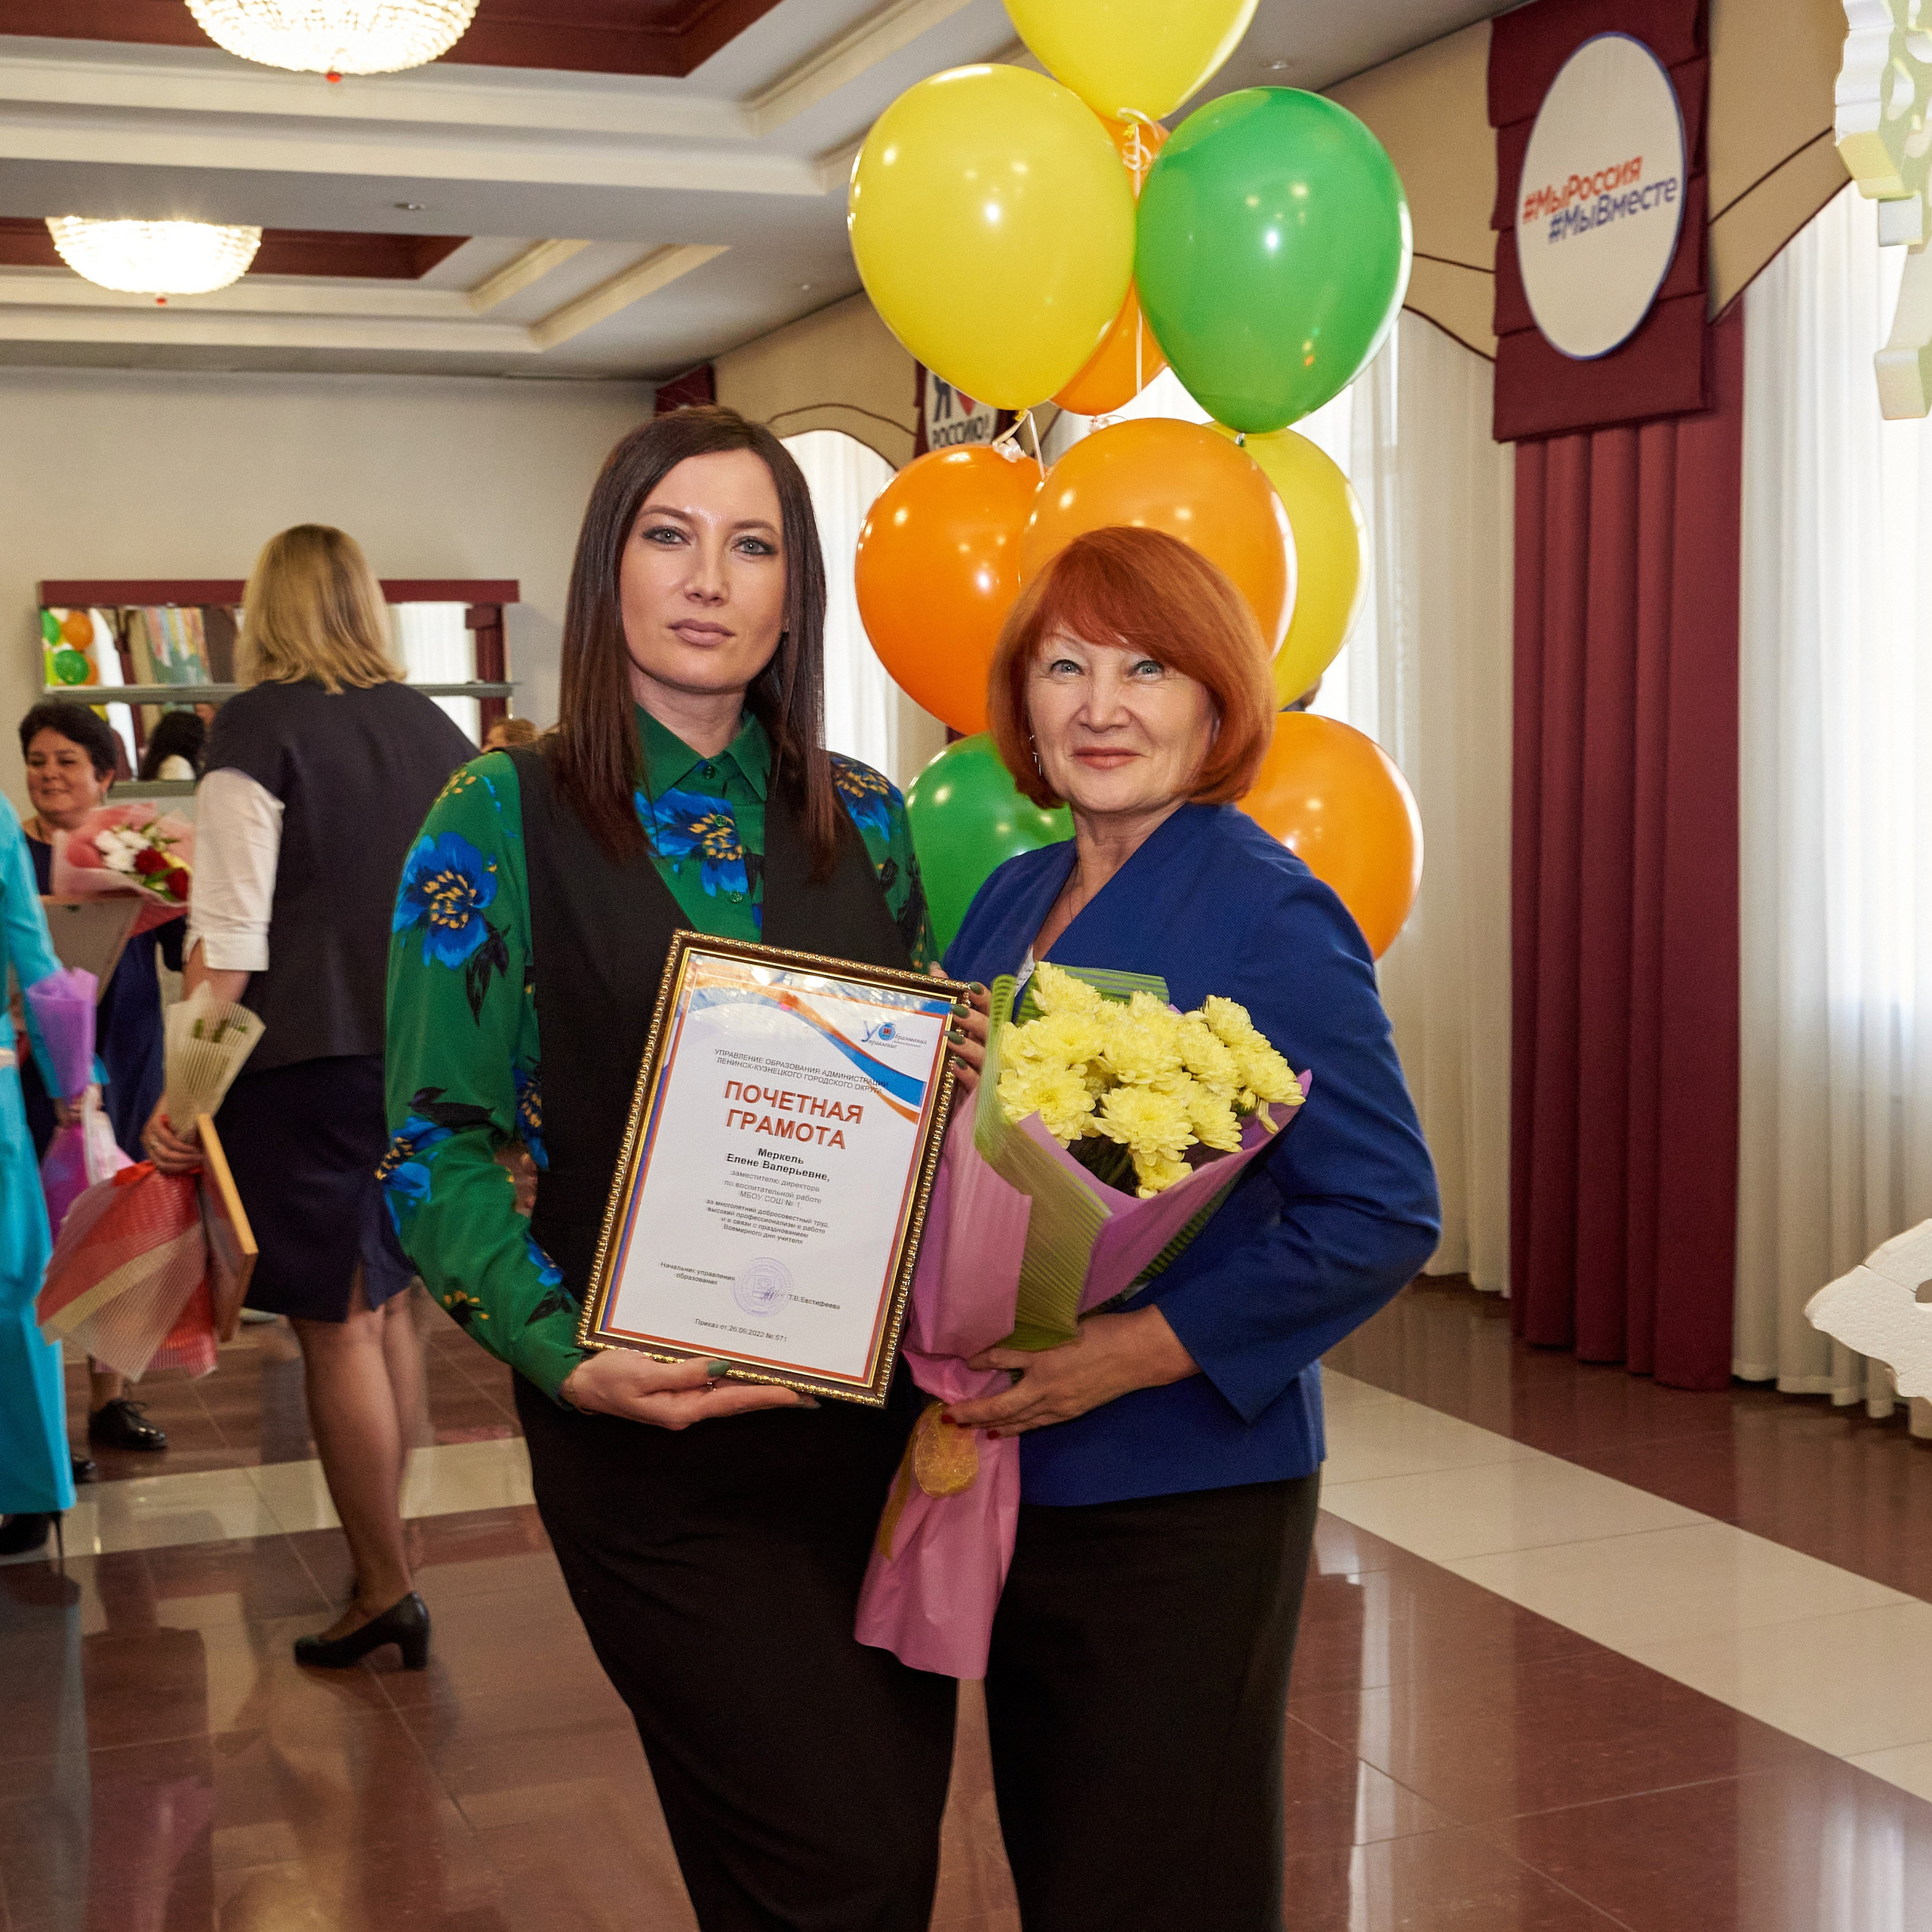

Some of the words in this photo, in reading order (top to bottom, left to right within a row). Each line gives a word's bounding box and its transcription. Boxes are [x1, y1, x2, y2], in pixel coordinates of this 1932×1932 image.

[1523, 155, 1644, 224] #МыРоссия
[1549, 177, 1678, 245] #МыВместе
[715, 1049, 764, 1063] УПРАВЛЕНИЕ
[765, 1059, 820, 1075] ОБРАЗОВАНИЯ
[822, 1069, 889, 1088] АДМИНИСТРАЦИИ
[716, 1057, 802, 1079] ЛЕНИНСК-КУЗНЕЦКОГО
[804, 1074, 853, 1089] ГОРОДСКОГО
[854, 1084, 883, 1095] ОКРУГА
[724, 1080, 864, 1124] ПОЧЕТНАЯ
[726, 1109, 846, 1150] ГРАМОТА
[727, 1153, 759, 1168] Елене
[762, 1160, 830, 1182] Валерьевне,
[758, 1148, 804, 1164] Меркель
[731, 1170, 780, 1185] заместителю
[781, 1180, 820, 1192] директора
[735, 1182, 794, 1198] воспитательной
[795, 1193, 823, 1204] работе
[740, 1190, 763, 1201] МБОУ
[764, 1195, 783, 1205] СОШ
[707, 1207, 735, 1217] высокий
[736, 1212, 795, 1229] профессионализм
[803, 1226, 826, 1235] работе
[715, 1200, 756, 1214] многолетний
[758, 1208, 812, 1225] добросовестный
[723, 1223, 762, 1237] Всемирного
[777, 1235, 804, 1245] учителя
[733, 1219, 752, 1227] связи
[758, 1223, 809, 1238] празднованием
[660, 1261, 696, 1274] Начальник
[697, 1269, 735, 1282] управления
[676, 1272, 718, 1285] образования
[695, 1318, 718, 1329] Приказ
[728, 1325, 764, 1338] 26.09.2022
